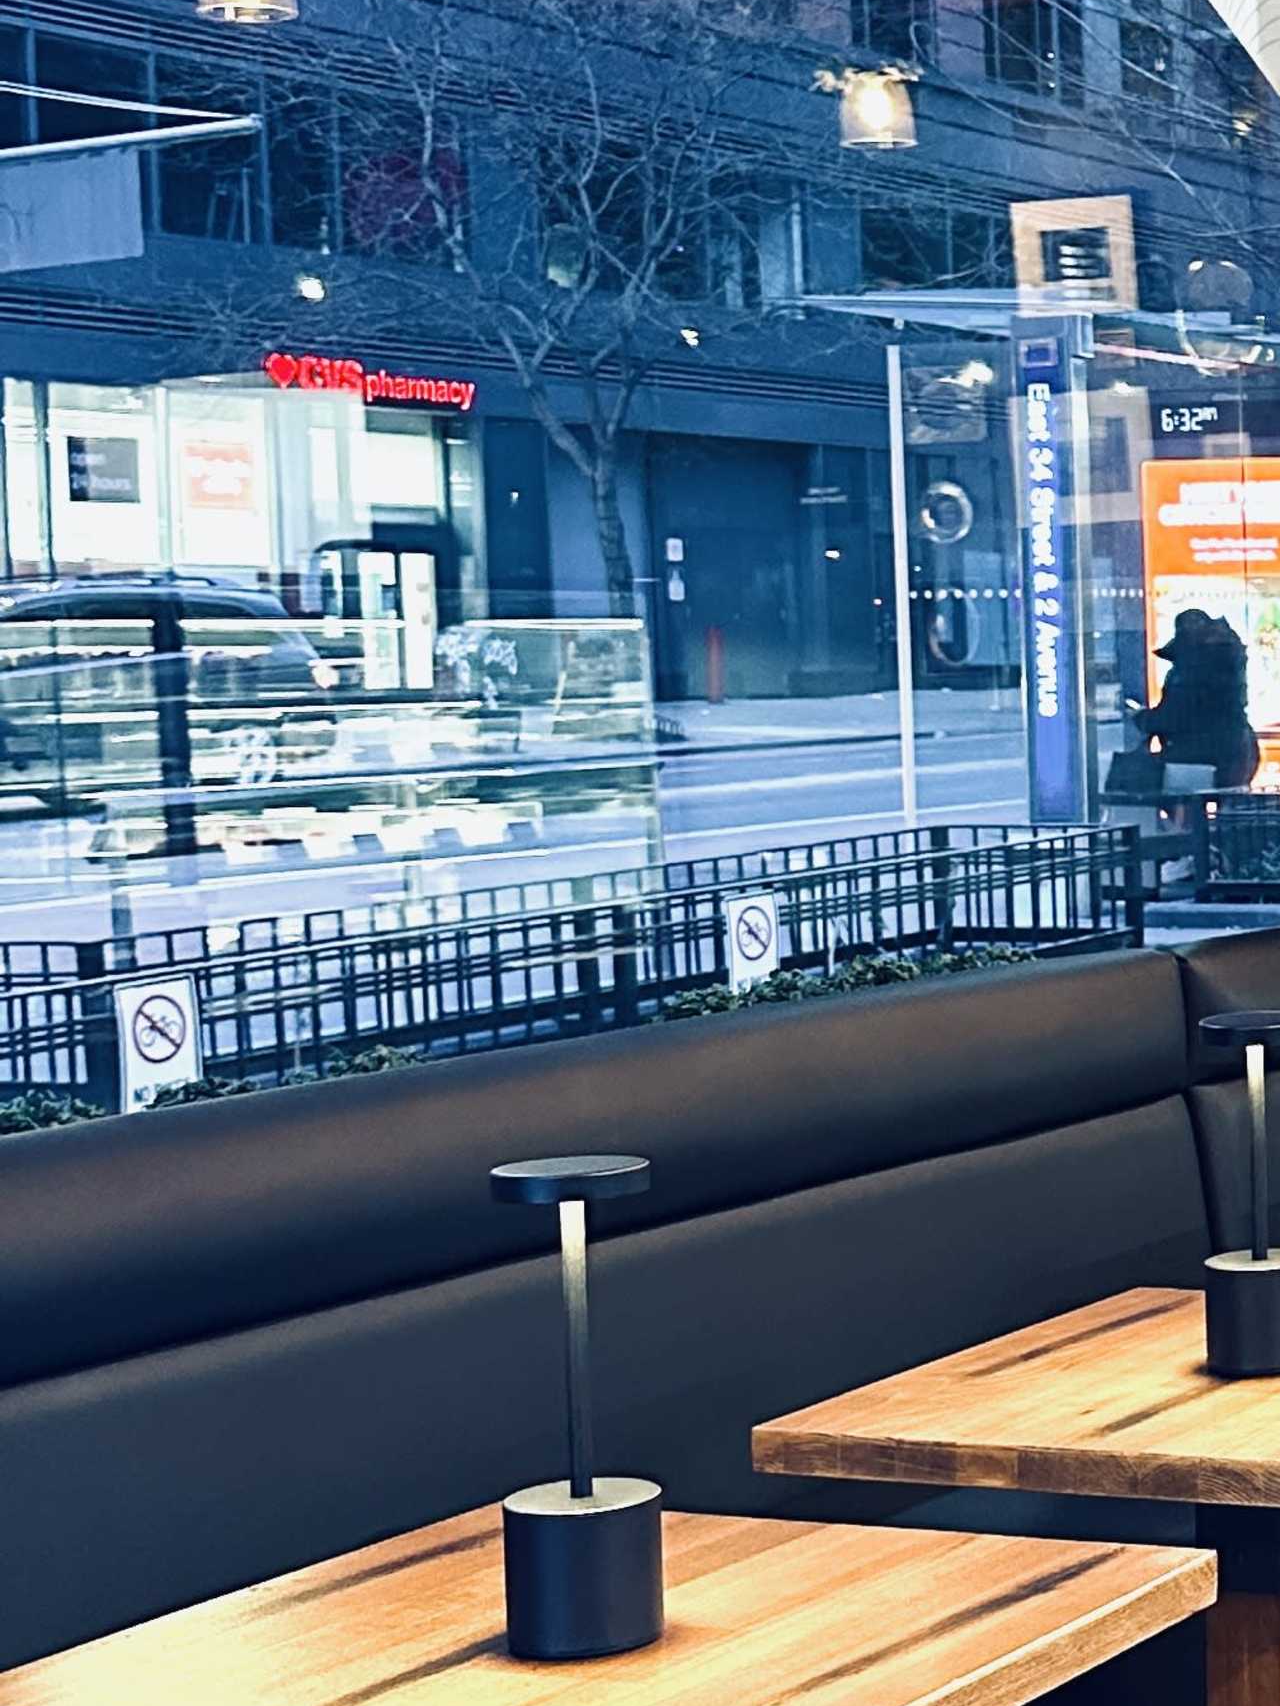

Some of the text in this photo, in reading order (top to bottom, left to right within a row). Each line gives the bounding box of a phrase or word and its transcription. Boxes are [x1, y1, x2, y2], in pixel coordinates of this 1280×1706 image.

[365, 369, 475, 410] pharmacy
[1027, 383, 1050, 443] East
[1028, 447, 1054, 482] 34
[1030, 486, 1056, 567] Street
[1034, 597, 1060, 617] 2
[1036, 619, 1061, 718] Avenue
